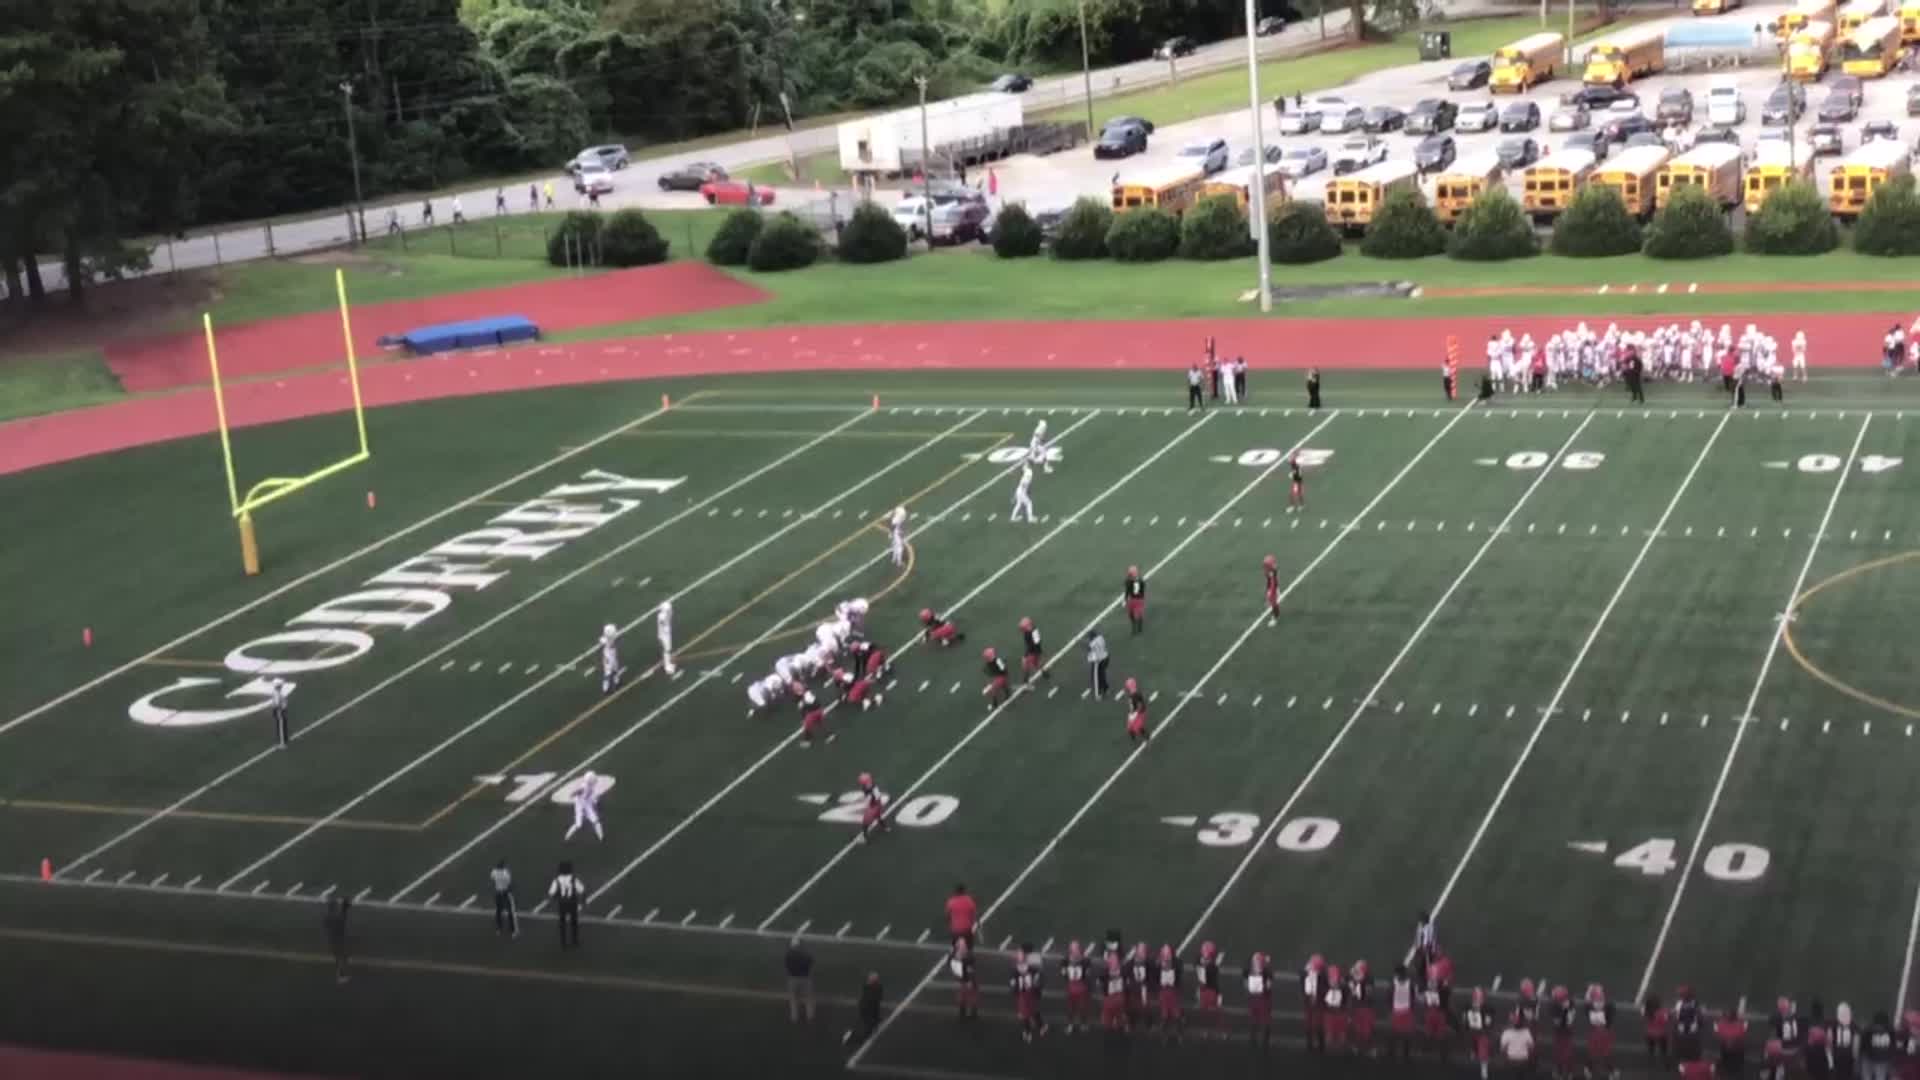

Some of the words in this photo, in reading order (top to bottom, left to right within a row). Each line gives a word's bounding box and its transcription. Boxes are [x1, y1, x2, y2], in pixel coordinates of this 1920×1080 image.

[128, 469, 688, 726] GODFREY
[1198, 812, 1340, 852] 30
[1614, 838, 1770, 881] 40
